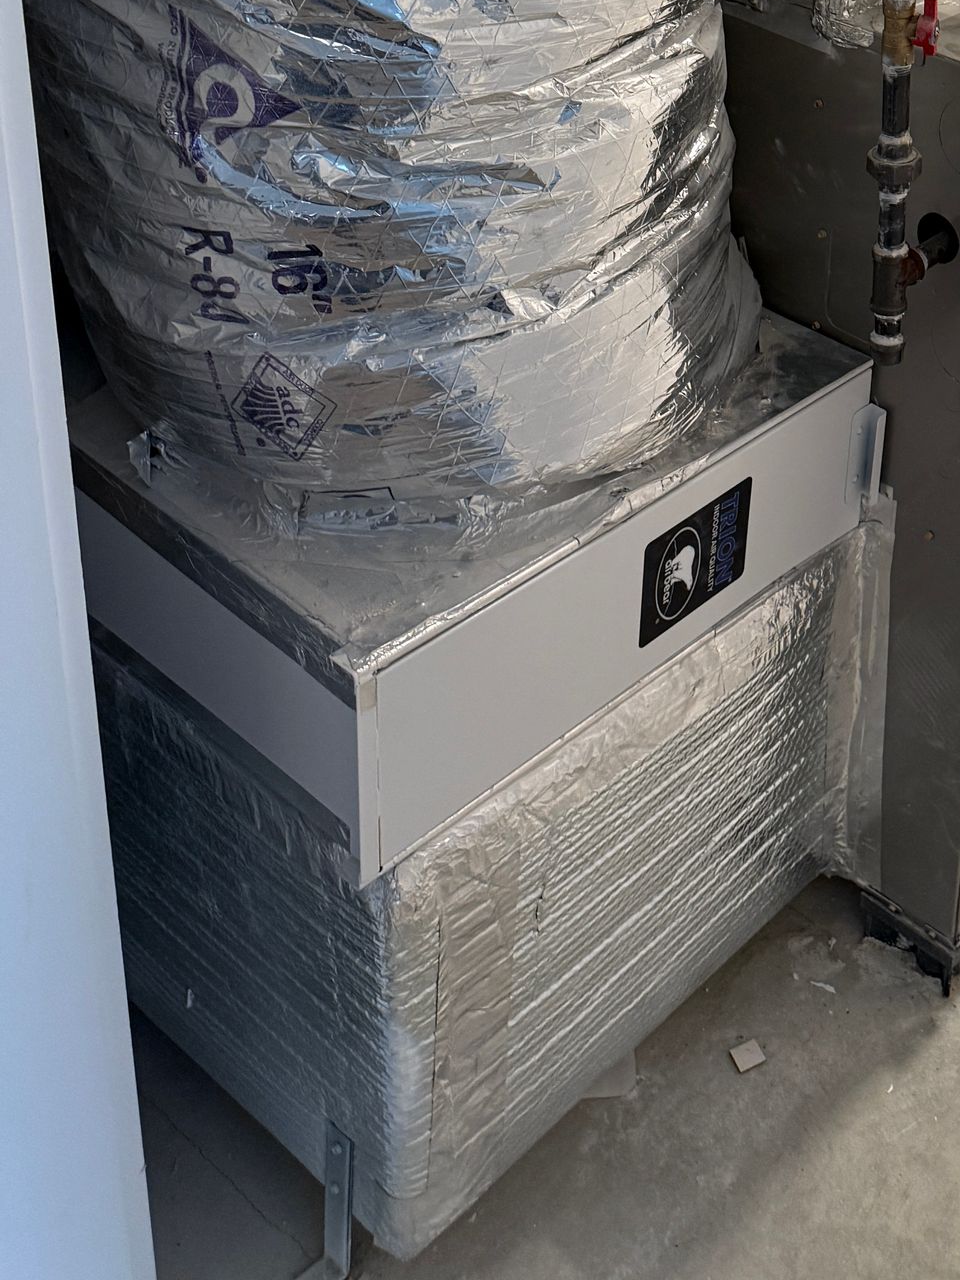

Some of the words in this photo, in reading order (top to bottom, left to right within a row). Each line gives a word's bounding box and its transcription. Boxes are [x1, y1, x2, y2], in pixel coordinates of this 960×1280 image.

[267, 244, 333, 314] 16"
[276, 386, 305, 429] adc
[711, 504, 721, 539] INDOOR
[714, 491, 740, 586] TRION
[710, 540, 719, 554] AIR
[706, 557, 716, 593] QUALITY
